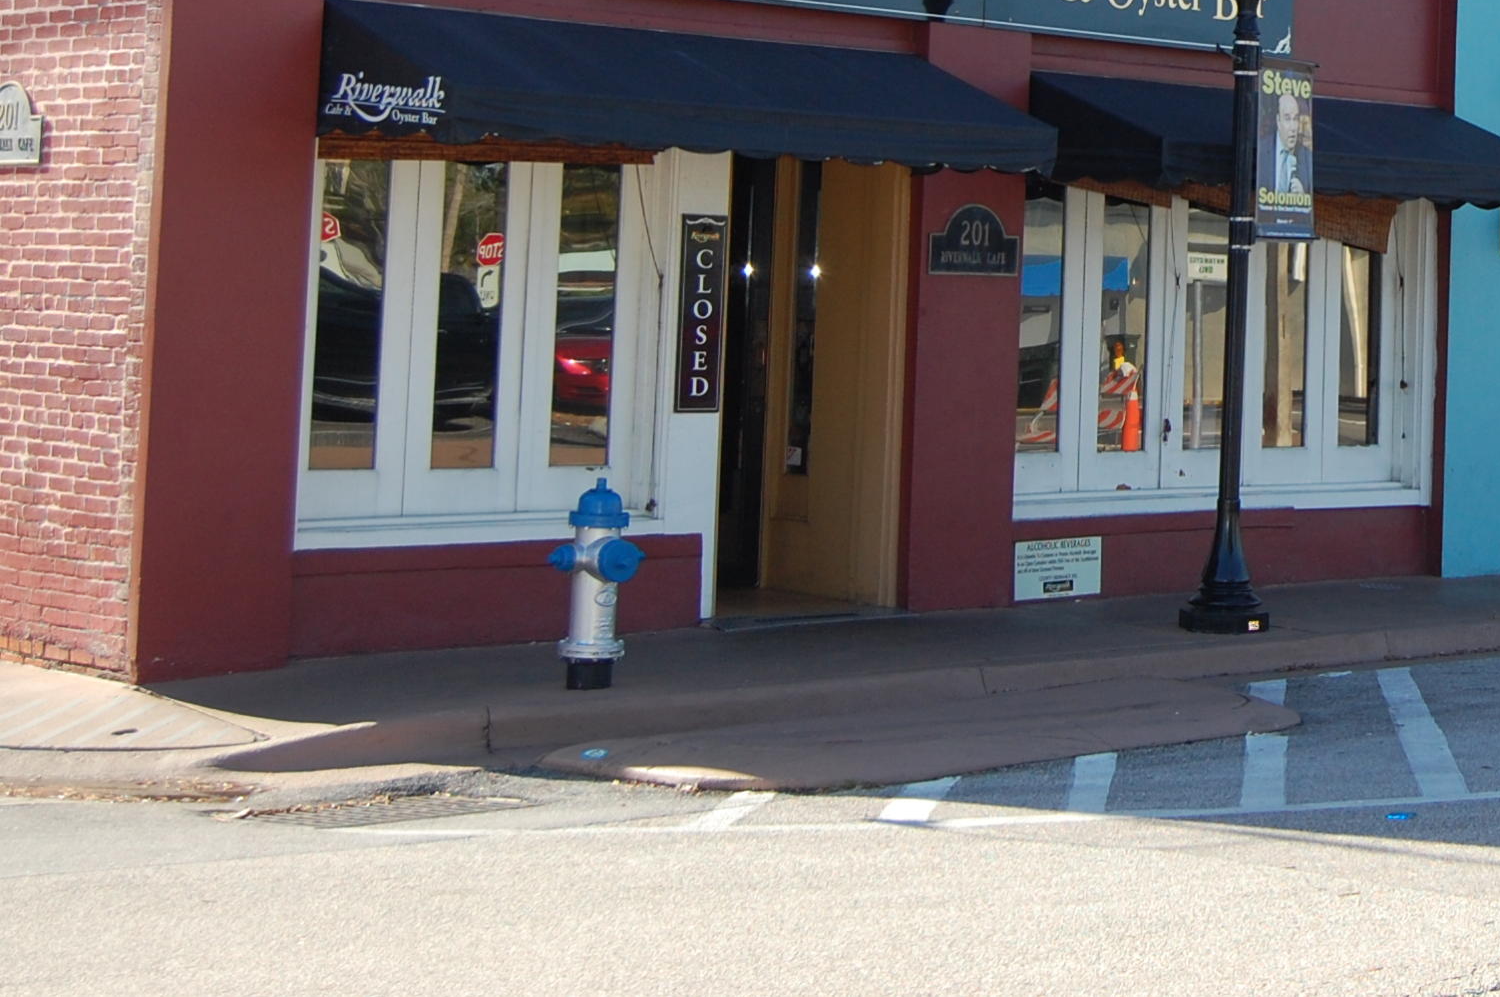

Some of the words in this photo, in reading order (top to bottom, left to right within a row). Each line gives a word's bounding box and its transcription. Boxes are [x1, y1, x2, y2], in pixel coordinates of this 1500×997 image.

[331, 71, 446, 122] Riverwalk
[1262, 69, 1312, 99] Steve
[392, 110, 419, 124] Oyster
[422, 112, 438, 125] Bar
[1259, 187, 1312, 207] Solomon
[960, 220, 990, 246] 201
[690, 249, 713, 396] CLOSED
